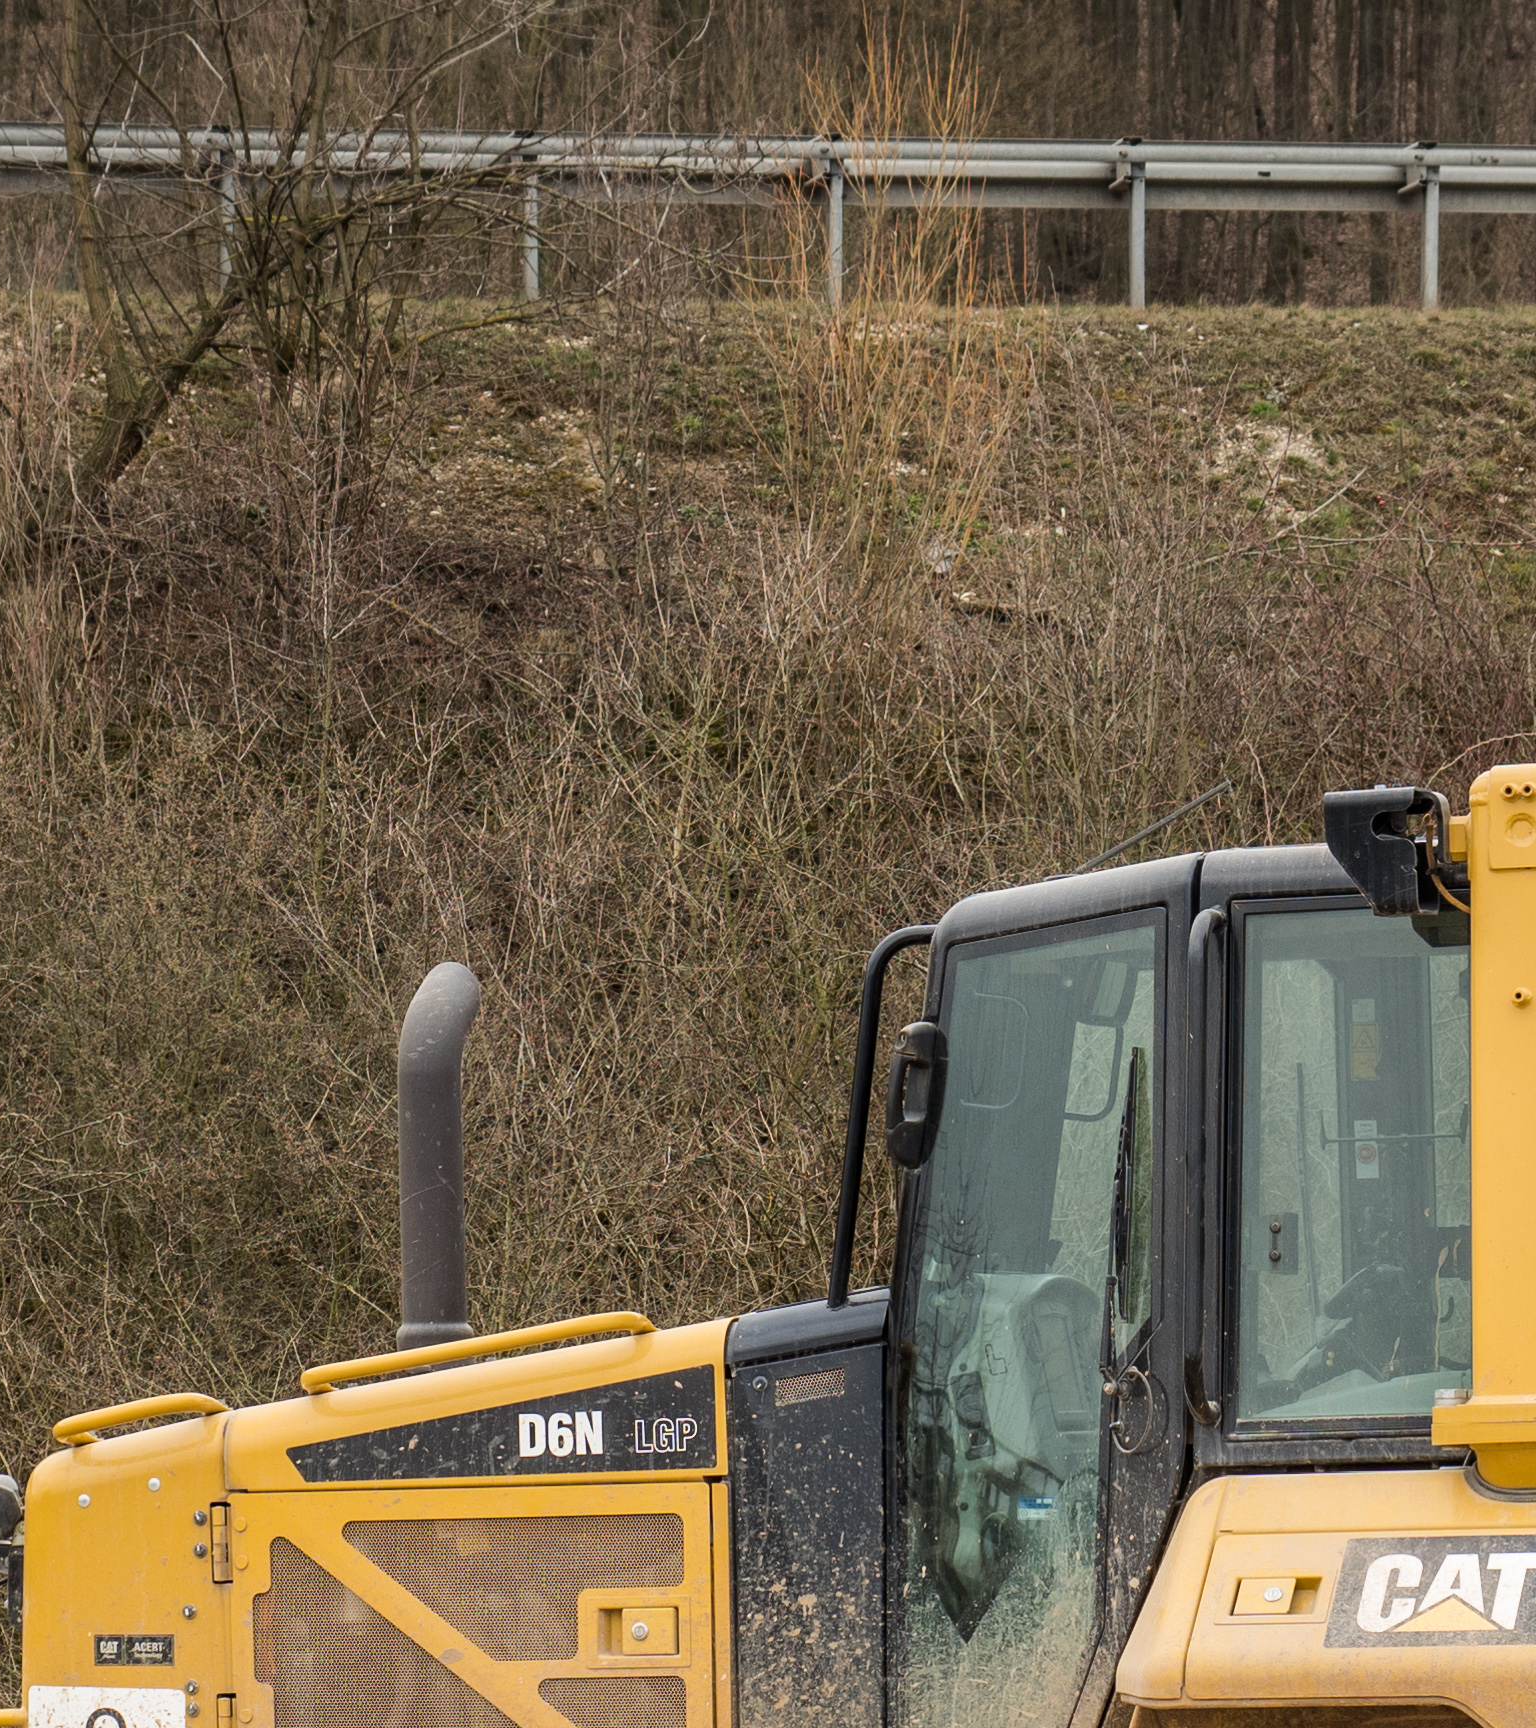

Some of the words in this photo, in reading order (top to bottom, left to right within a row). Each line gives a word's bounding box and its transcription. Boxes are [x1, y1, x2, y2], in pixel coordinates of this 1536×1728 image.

[518, 1410, 604, 1458] D6N
[634, 1417, 698, 1454] LGP
[99, 1640, 119, 1654] CAT
